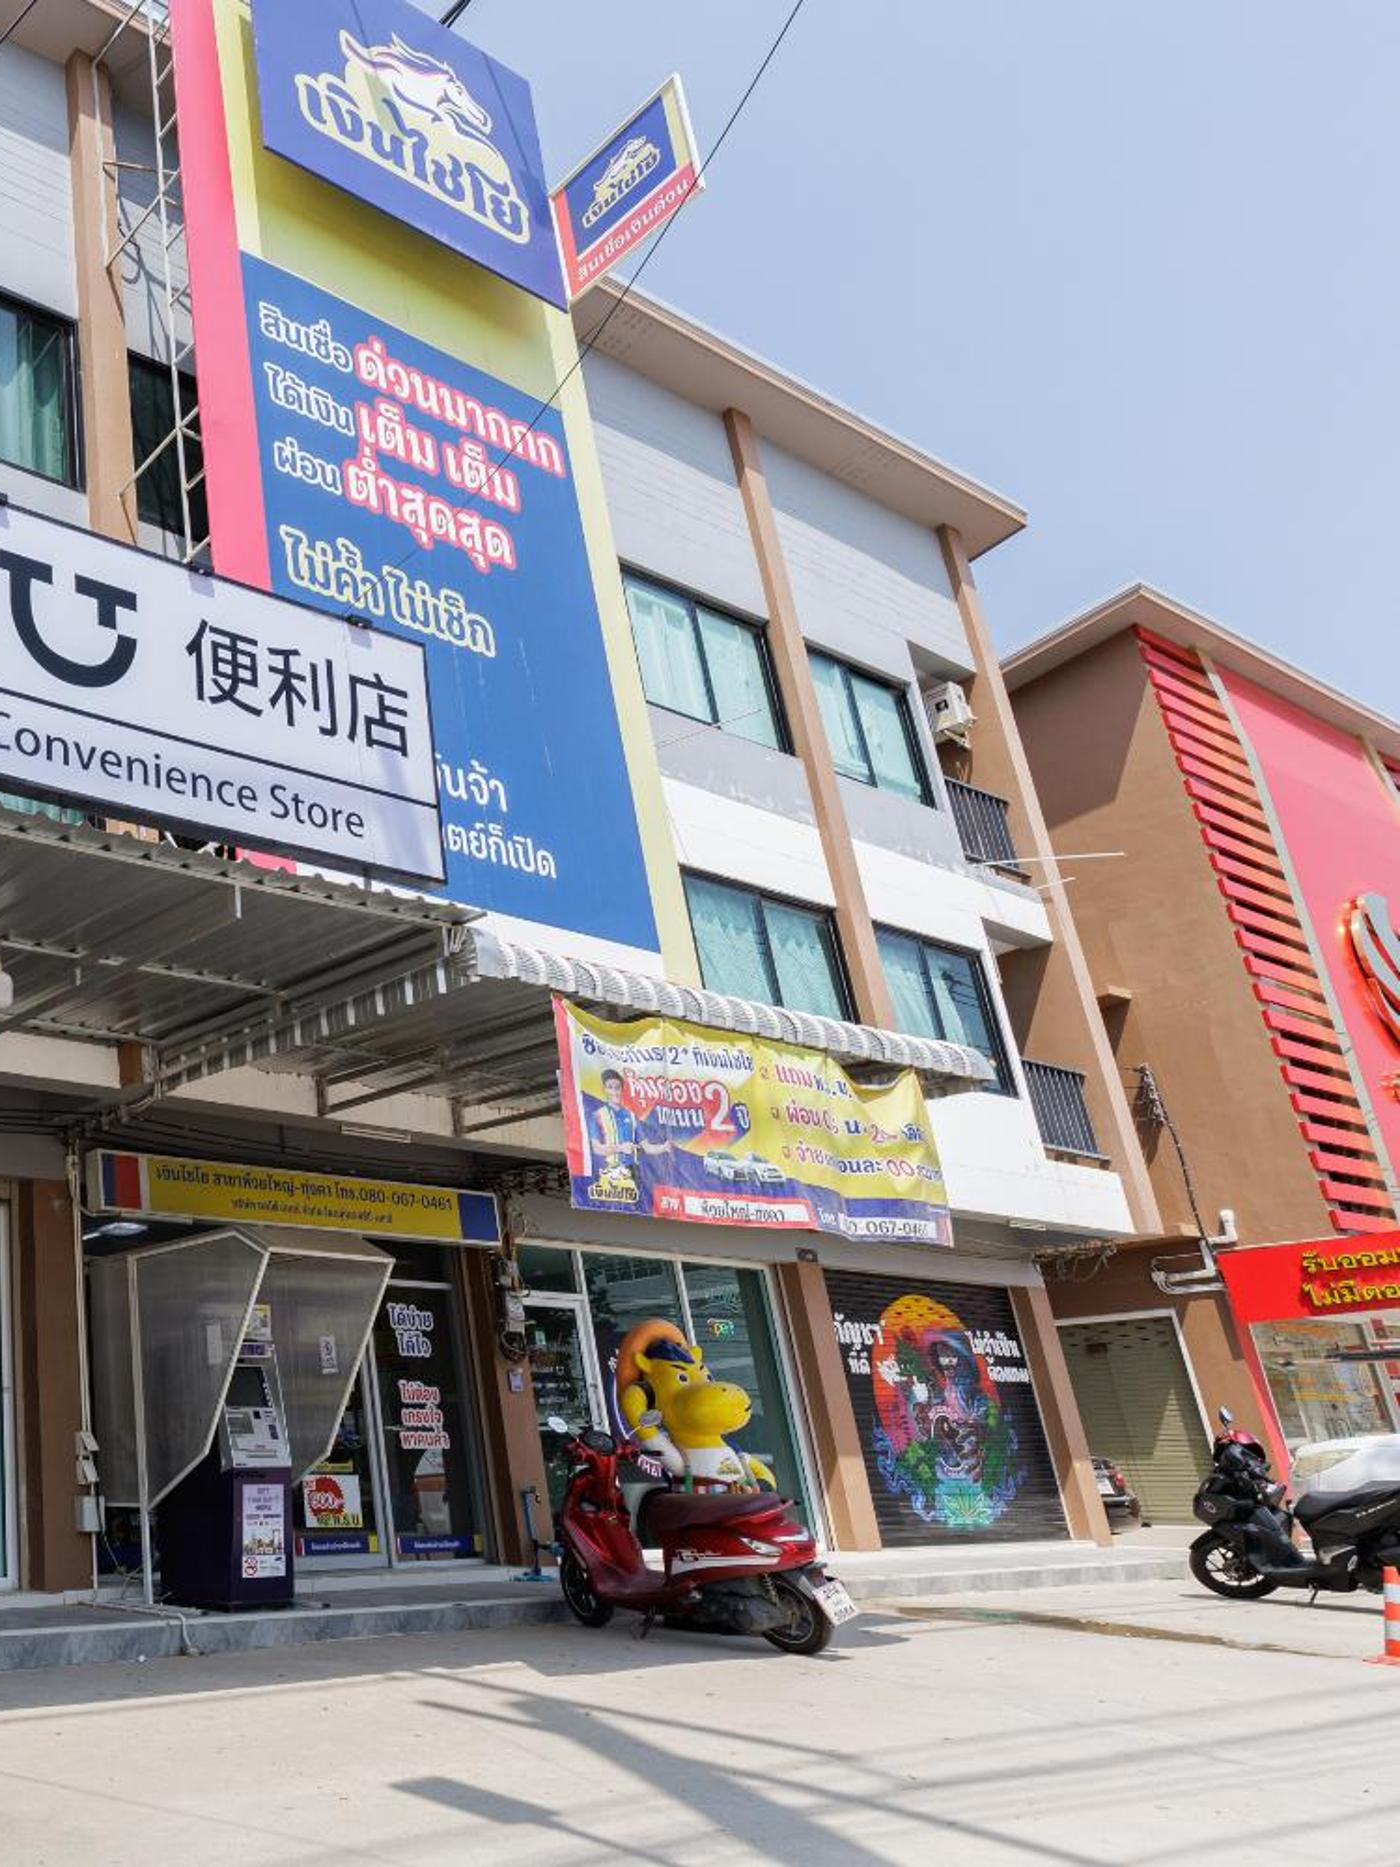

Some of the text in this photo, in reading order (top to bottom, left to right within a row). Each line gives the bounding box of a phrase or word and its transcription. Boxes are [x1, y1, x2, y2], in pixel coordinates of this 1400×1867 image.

[259, 301, 353, 373] สินเชื่อ
[274, 437, 342, 495] ผ่อน
[357, 397, 438, 477] เต็ม
[444, 438, 520, 511] เต็ม
[186, 619, 410, 758] 便利店
[269, 782, 367, 838] Store
[704, 1081, 736, 1132] 2
[1302, 1247, 1400, 1274] รับออม
